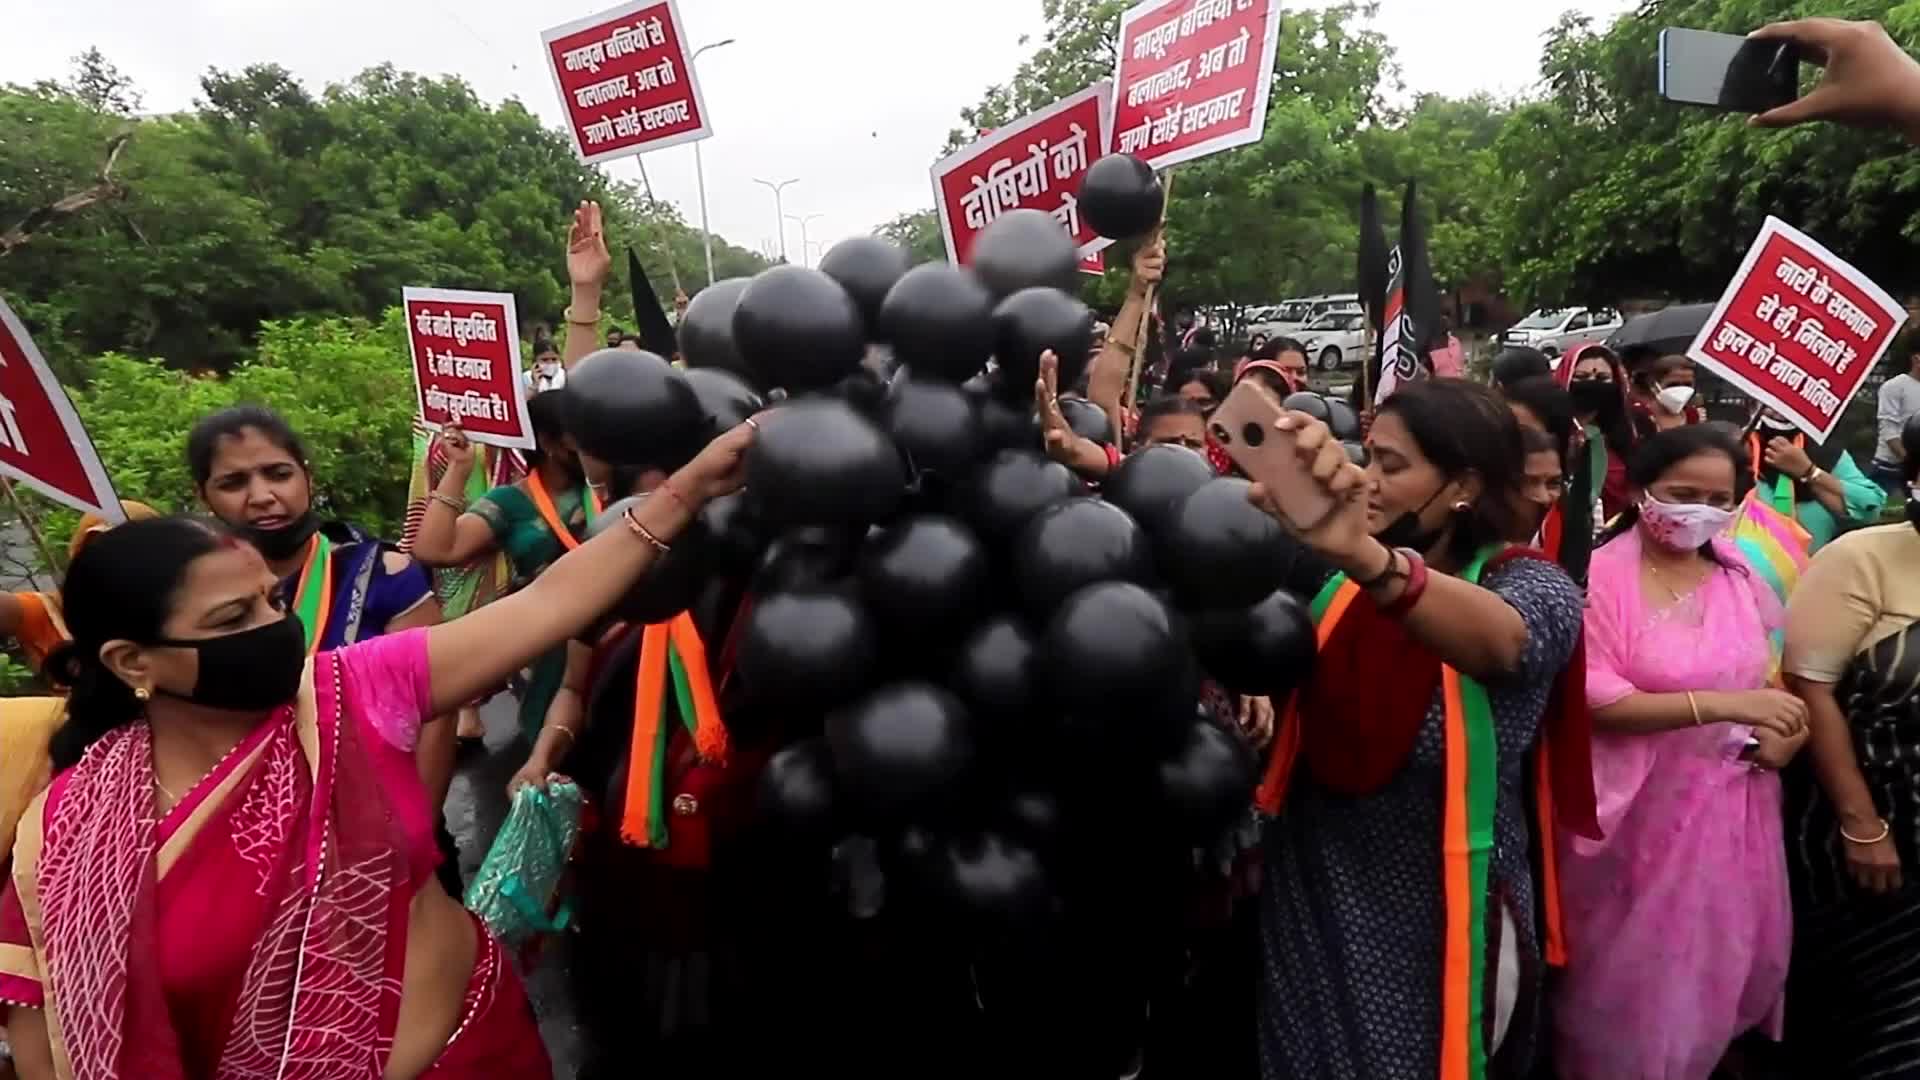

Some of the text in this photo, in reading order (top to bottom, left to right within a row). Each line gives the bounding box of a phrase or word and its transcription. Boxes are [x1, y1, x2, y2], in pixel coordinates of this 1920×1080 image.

[562, 16, 666, 74] मासूम बच्चियों से
[1132, 16, 1181, 60] मासूम
[1196, 44, 1227, 79] अब
[1226, 26, 1251, 67] तो
[635, 67, 659, 91] अब
[657, 56, 676, 83] तो
[582, 115, 615, 144] जागो
[640, 100, 690, 130] सरकार
[1119, 115, 1153, 153] जागो
[1182, 88, 1246, 135] सरकार
[960, 139, 1049, 229] दोषियों
[1049, 122, 1087, 180] को
[1775, 256, 1878, 341] नारी के सम्मान
[453, 312, 497, 346] सुरक्षित
[1713, 321, 1755, 356] कुल
[1749, 339, 1776, 370] को
[1769, 355, 1806, 391] मान
[1755, 294, 1779, 322] से
[1794, 317, 1846, 367] मिलती
